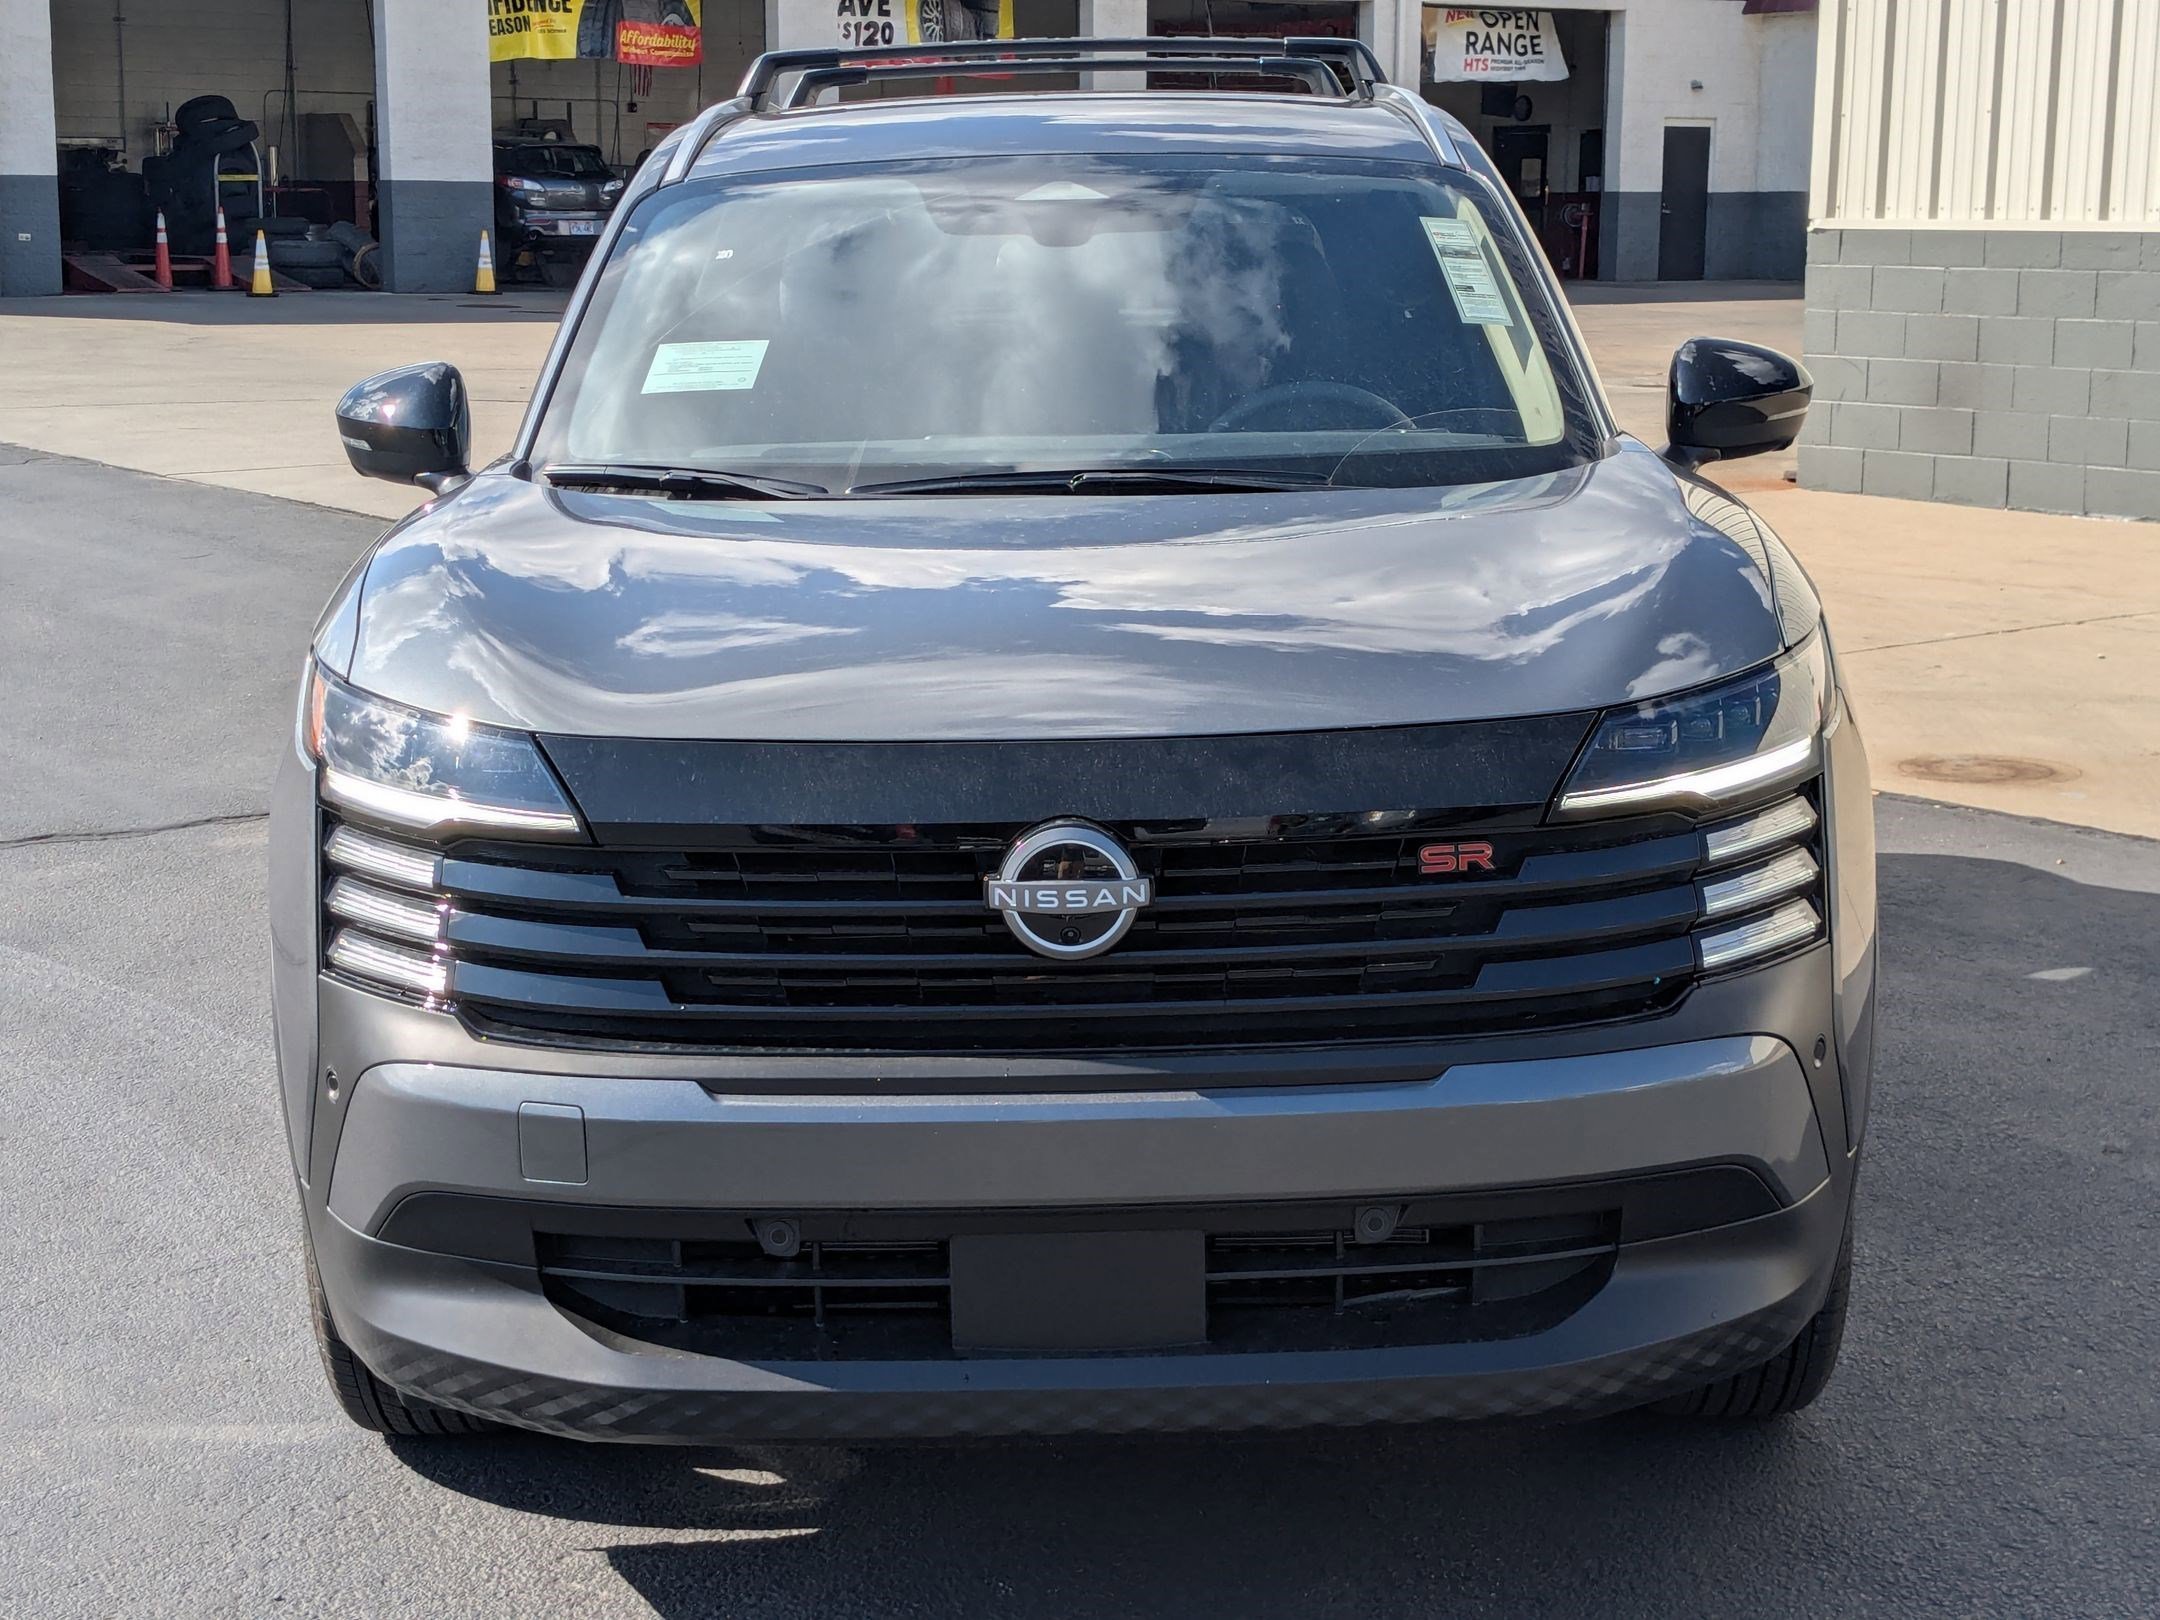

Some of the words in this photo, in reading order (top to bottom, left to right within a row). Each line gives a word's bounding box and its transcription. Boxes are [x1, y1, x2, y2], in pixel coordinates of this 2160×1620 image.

[489, 15, 531, 36] EASON
[1479, 11, 1539, 31] OPEN
[620, 29, 695, 51] Affordability
[842, 21, 894, 46] $120
[1465, 31, 1543, 57] RANGE
[1464, 58, 1489, 72] HTS
[1419, 841, 1495, 873] SR
[994, 884, 1146, 908] NISSAN
